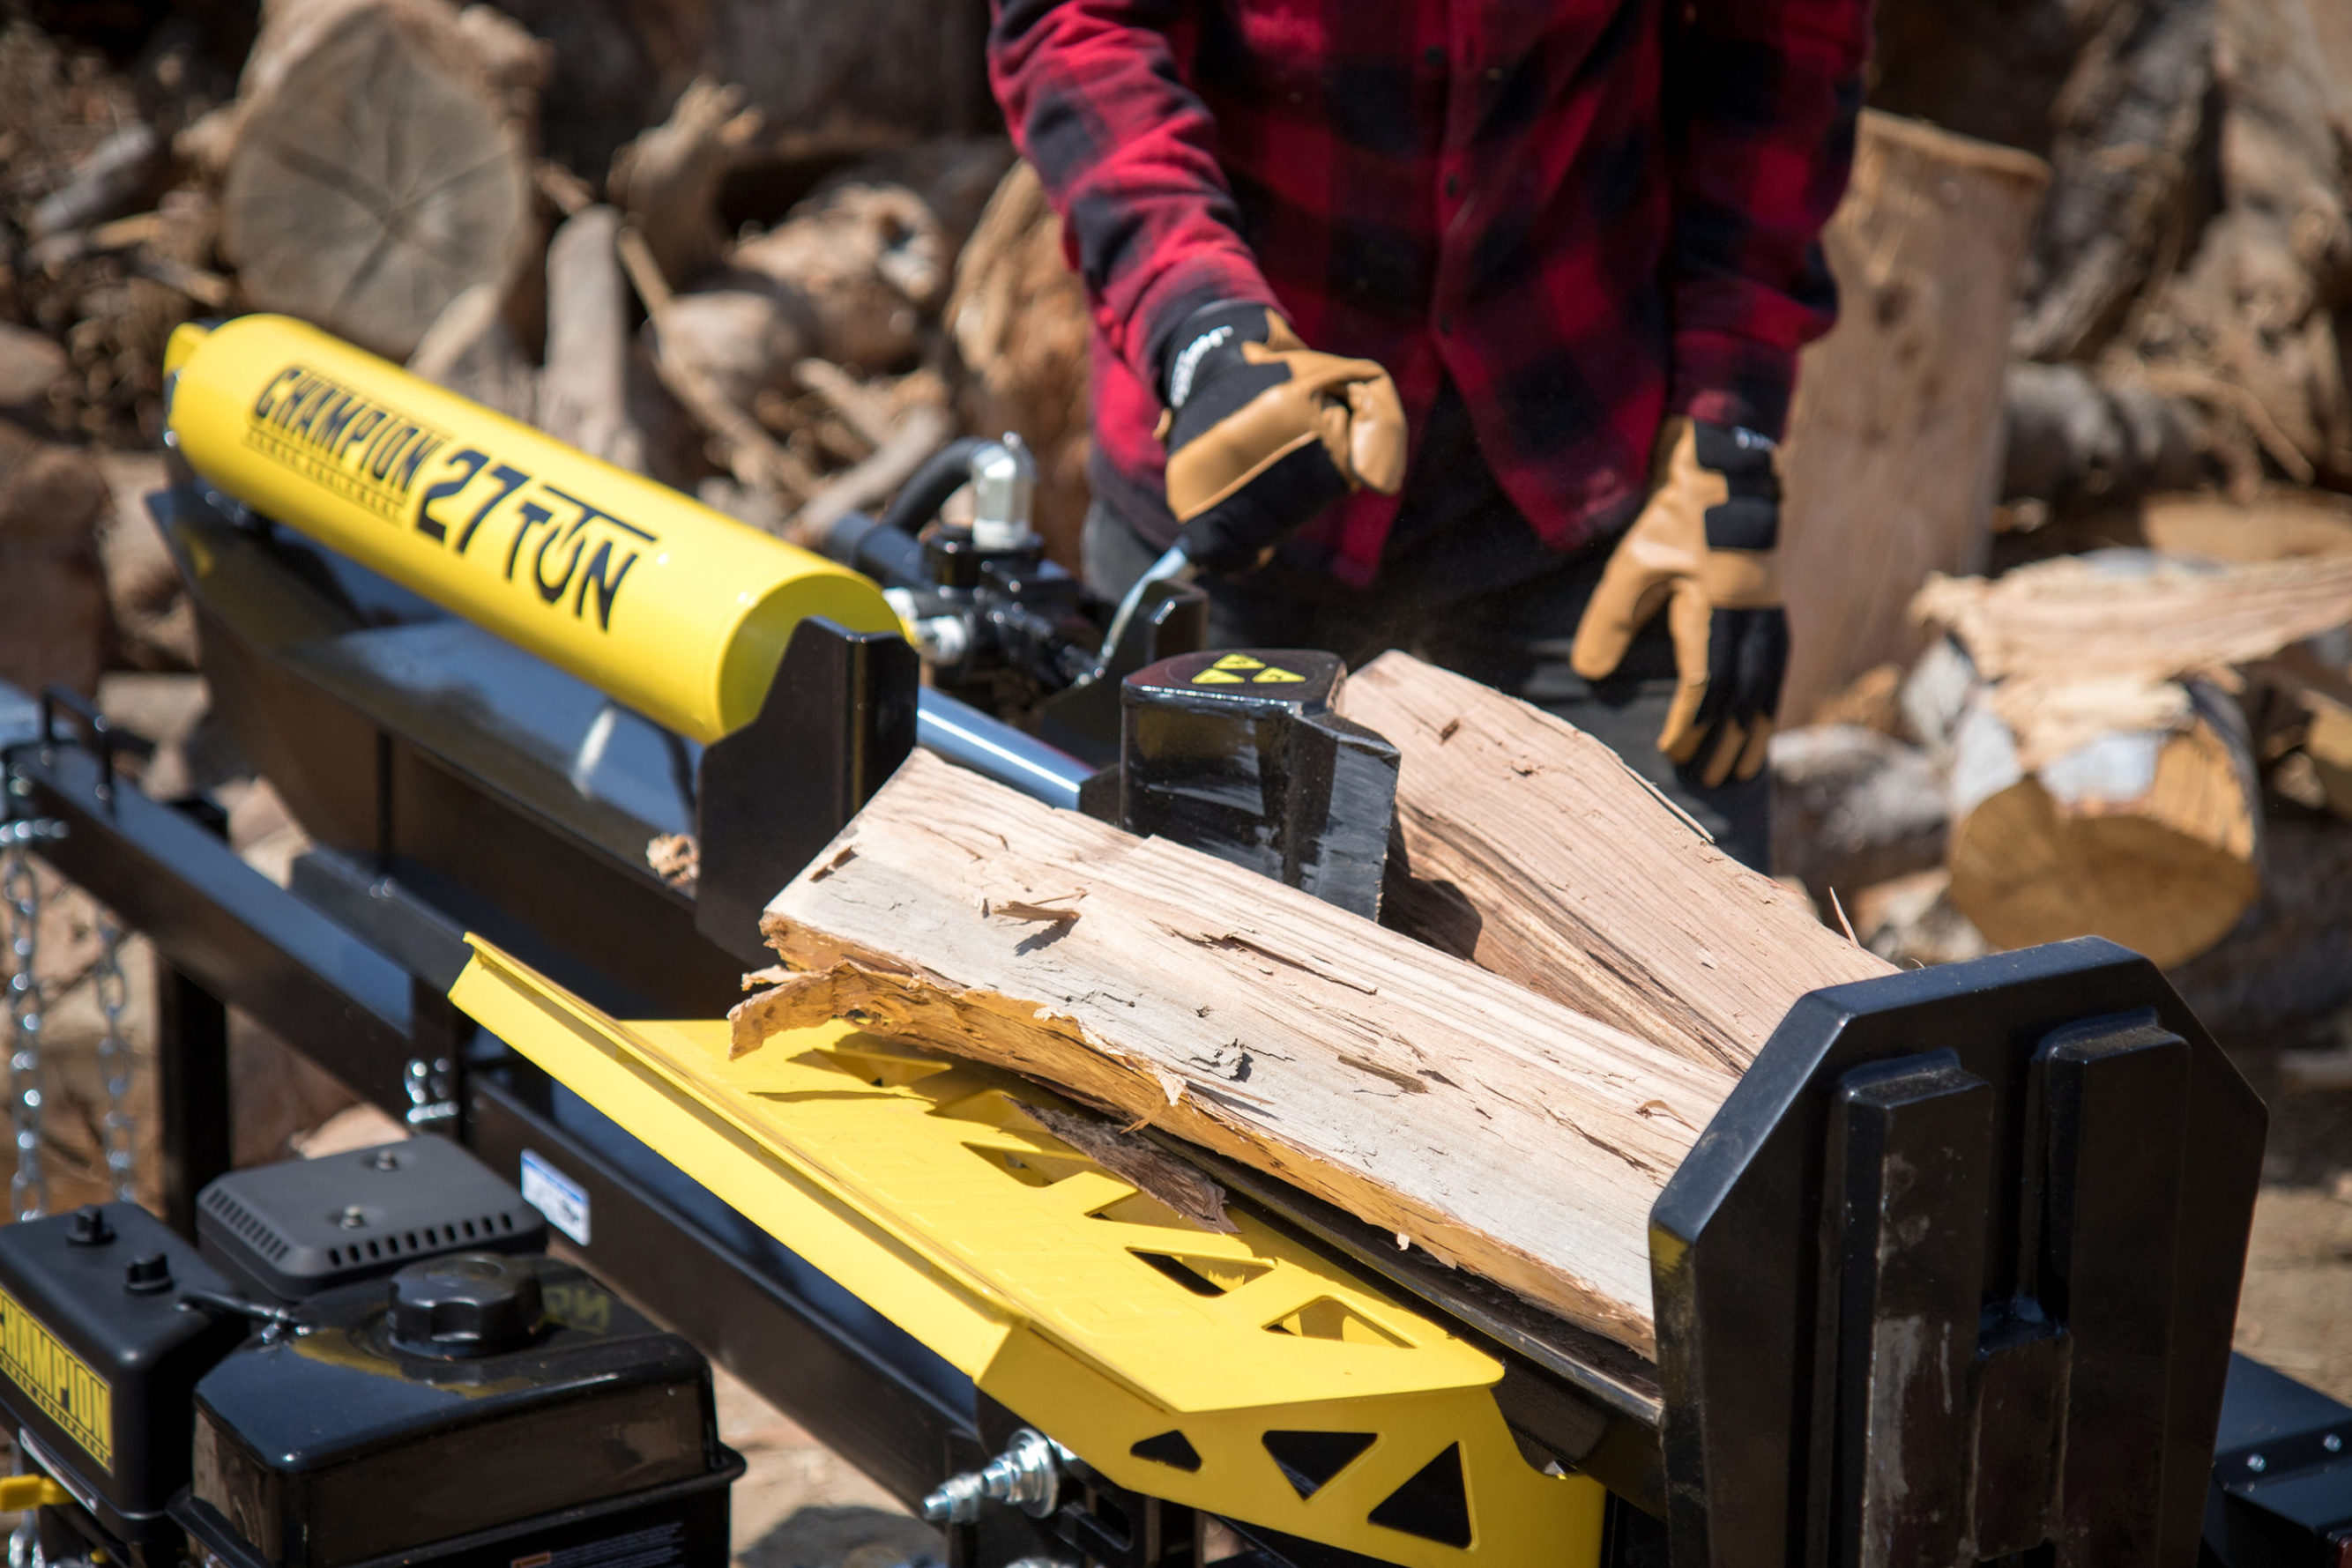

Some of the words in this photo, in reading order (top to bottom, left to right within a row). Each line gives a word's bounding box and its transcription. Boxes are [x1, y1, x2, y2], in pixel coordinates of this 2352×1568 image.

[254, 366, 443, 494] CHAMPION
[415, 448, 532, 555] 27
[505, 494, 644, 634] TON
